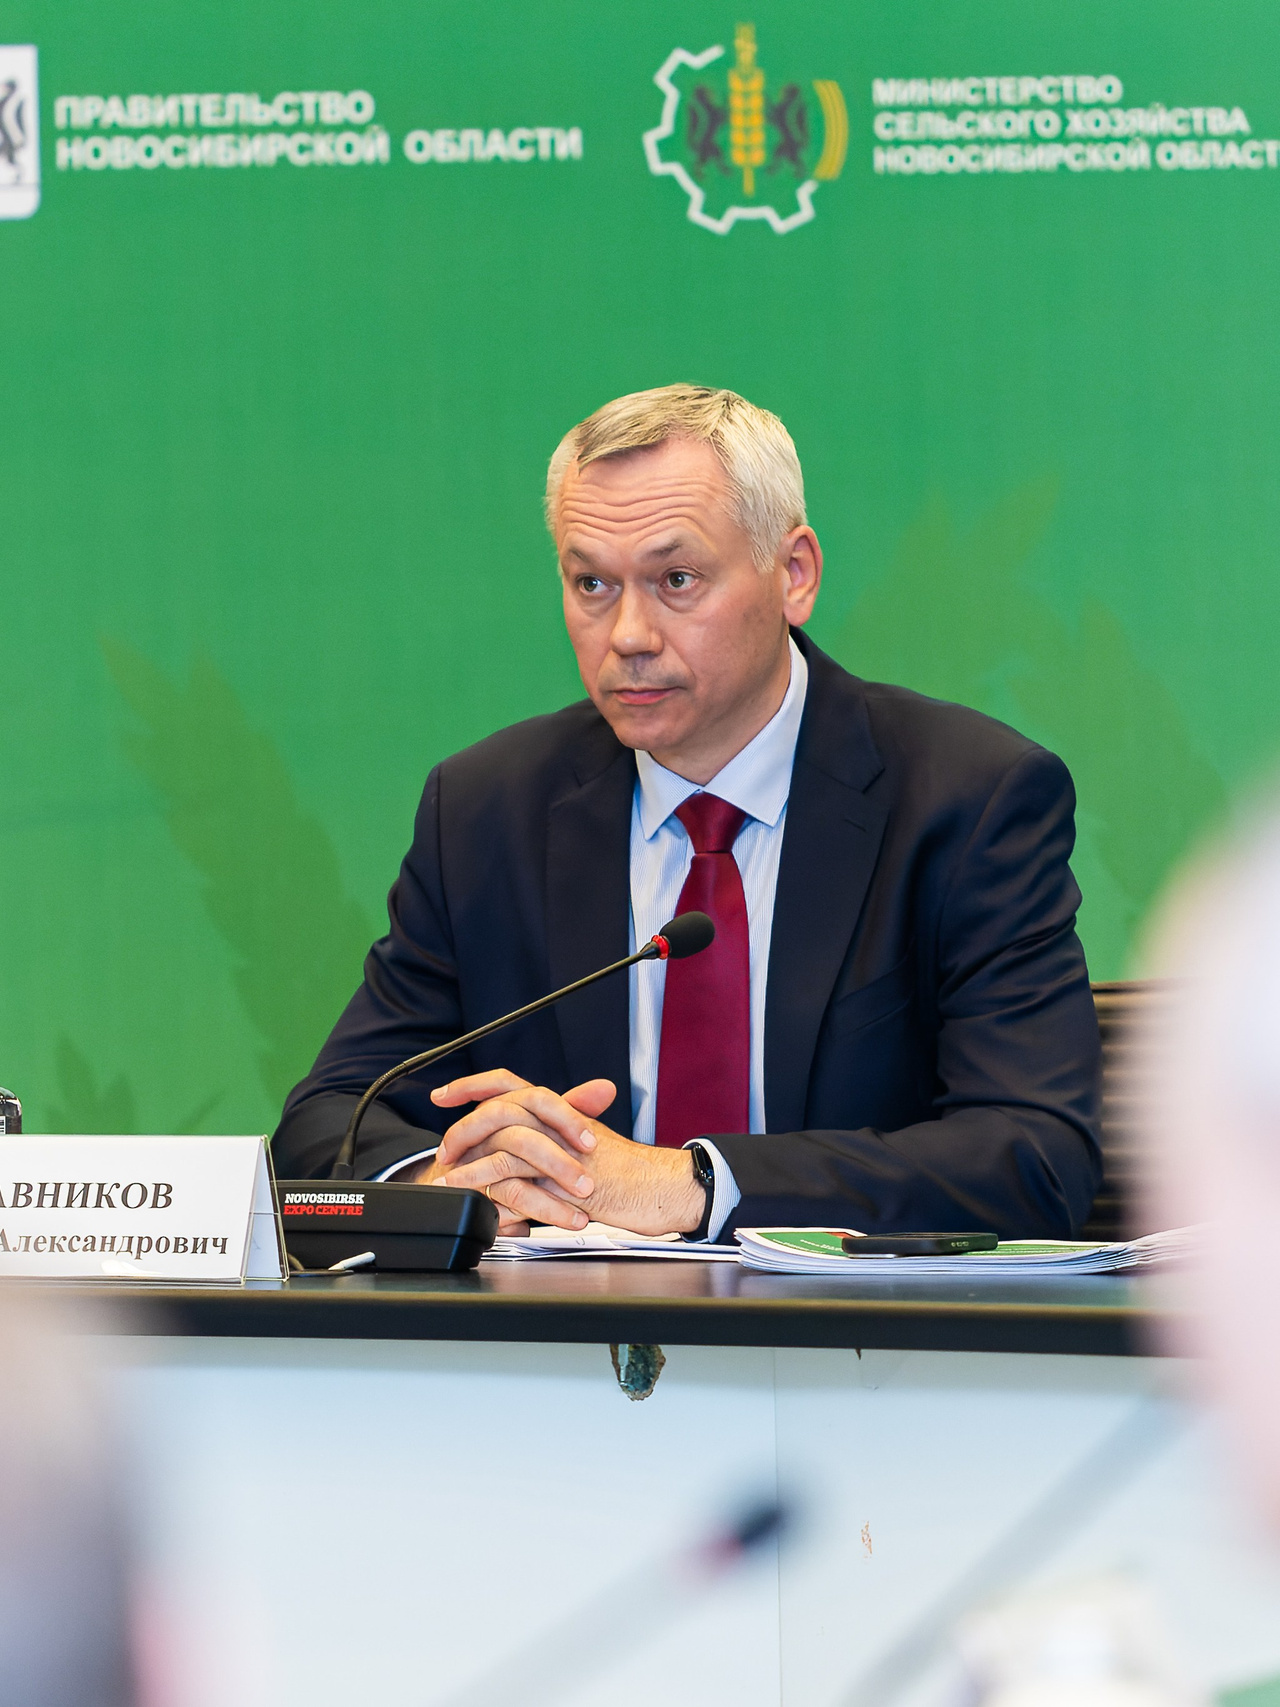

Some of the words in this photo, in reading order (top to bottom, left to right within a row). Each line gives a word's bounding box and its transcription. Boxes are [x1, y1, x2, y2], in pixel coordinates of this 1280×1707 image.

[871, 74, 1123, 106] МИНИСТЕРСТВО
[53, 90, 376, 129] ПРАВИТЕЛЬСТВО
[873, 109, 1061, 141] СЕЛЬСКОГО
[1064, 103, 1251, 138] ХОЗЯЙСТВА
[55, 126, 391, 170] НОВОСИБИРСКОЙ
[403, 127, 583, 164] ОБЛАСТИ
[873, 138, 1151, 174] НОВОСИБИРСКОЙ
[283, 1205, 314, 1215] EXPO
[315, 1205, 363, 1216] CENTRE
[285, 1193, 365, 1205] NOVOSIBIRSK
